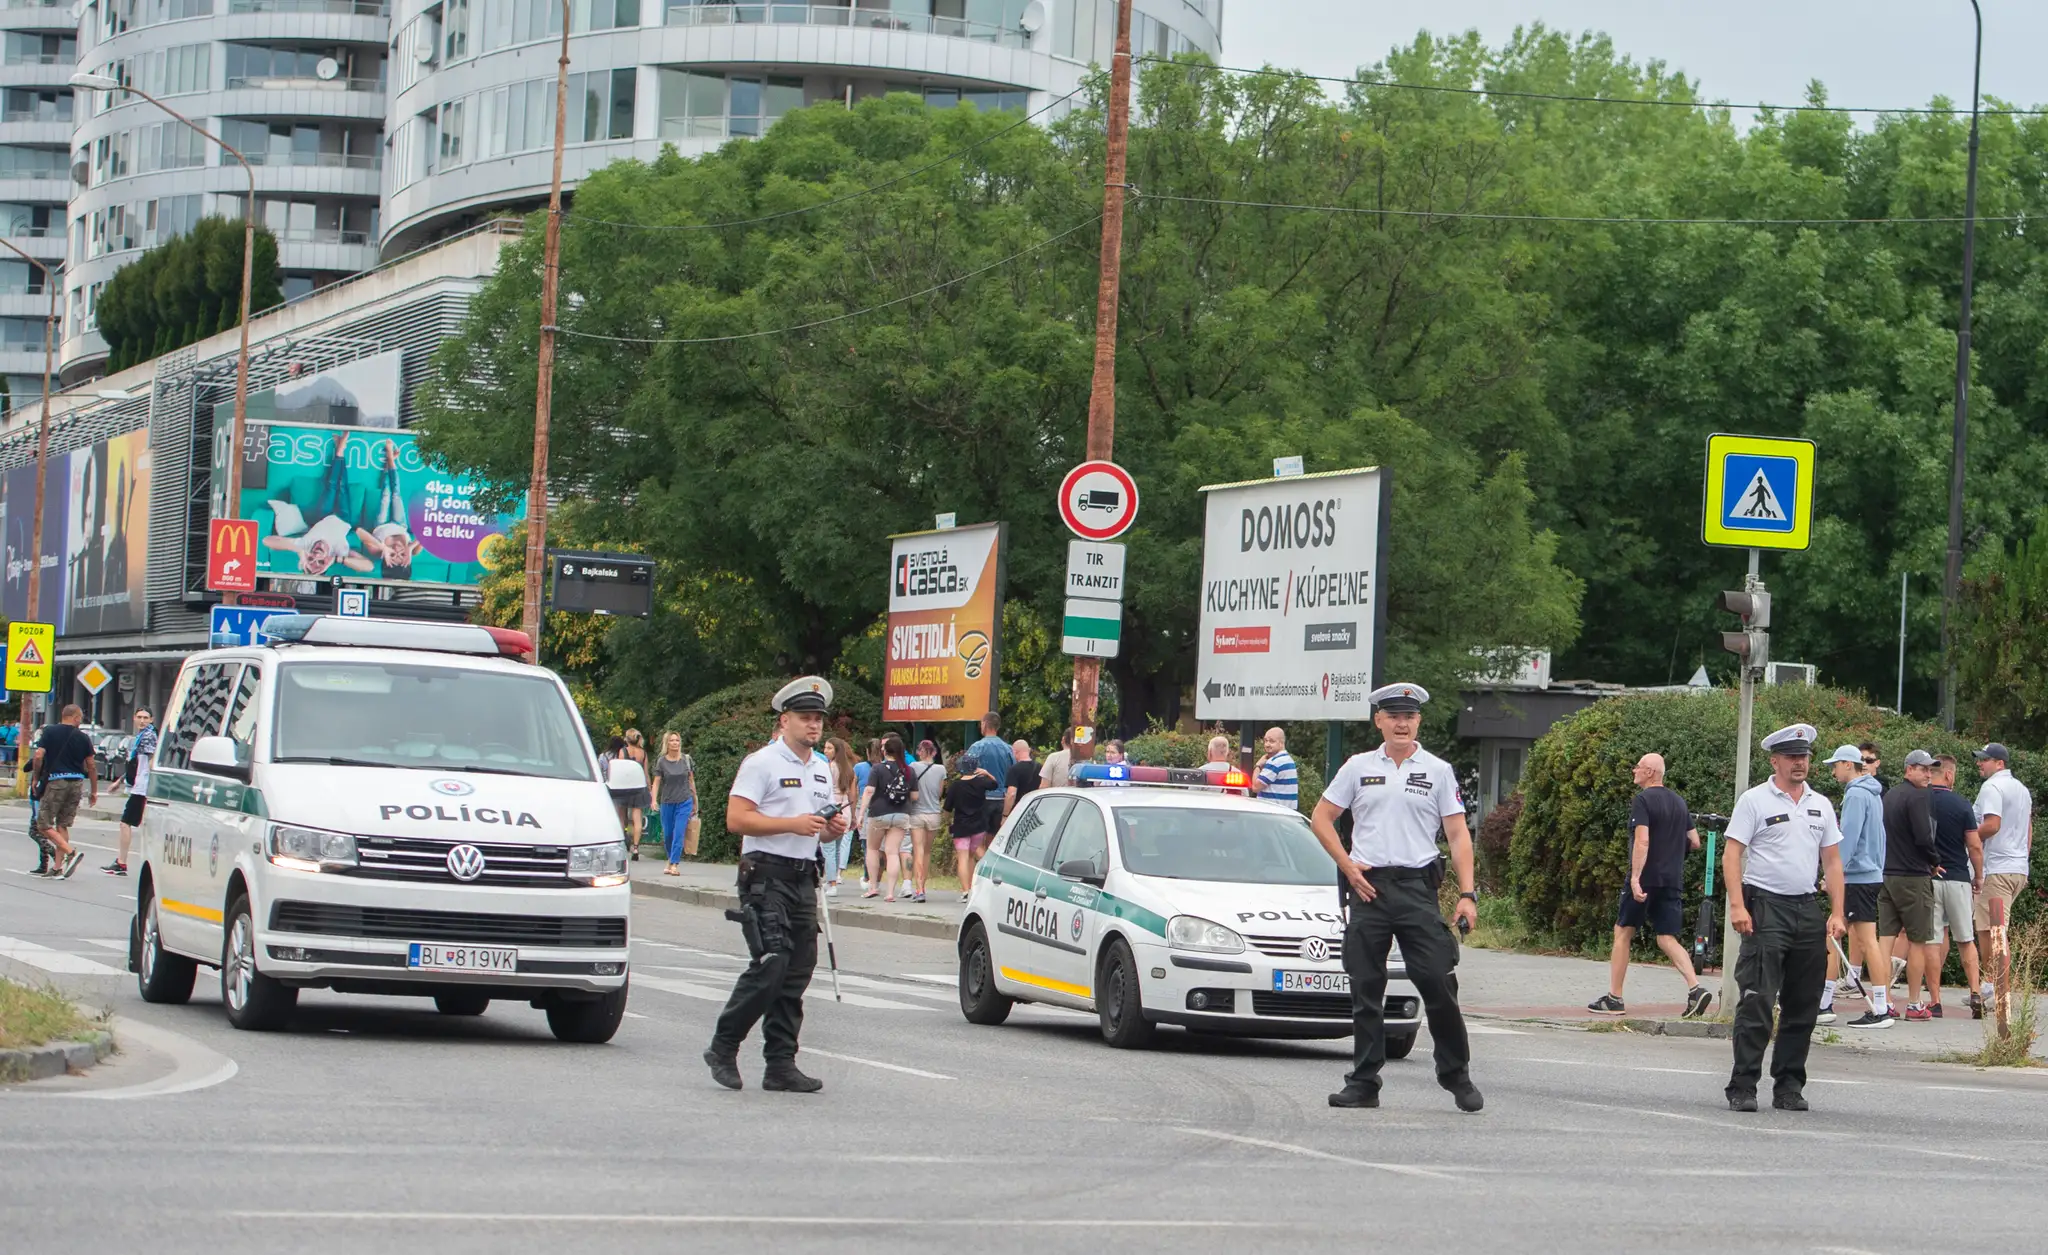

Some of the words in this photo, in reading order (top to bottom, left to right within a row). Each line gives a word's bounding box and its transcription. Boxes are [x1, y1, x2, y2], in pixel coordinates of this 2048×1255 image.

[425, 480, 453, 494] 4ka
[425, 495, 438, 511] aj
[423, 526, 432, 537] a
[436, 525, 475, 539] telku
[1086, 552, 1104, 566] TIR
[333, 576, 341, 585] E
[1070, 573, 1119, 590] TRANZIT
[1207, 577, 1280, 612] KUCHYNE
[1296, 566, 1369, 608] KÚPEĽNE
[18, 627, 45, 635] POZOR
[891, 613, 957, 660] SVIETIDLÁ
[17, 668, 40, 678] ŠKOLA
[1223, 683, 1236, 697] 100
[1238, 686, 1245, 696] m
[1249, 682, 1318, 696] www.studiadomoss.sk
[1334, 689, 1361, 702] Bratislava
[1404, 787, 1429, 797] POLÍCIA
[379, 804, 543, 829] POLÍCIA
[163, 828, 192, 868] POLÍCIA
[1006, 897, 1058, 940] POLÍCIA
